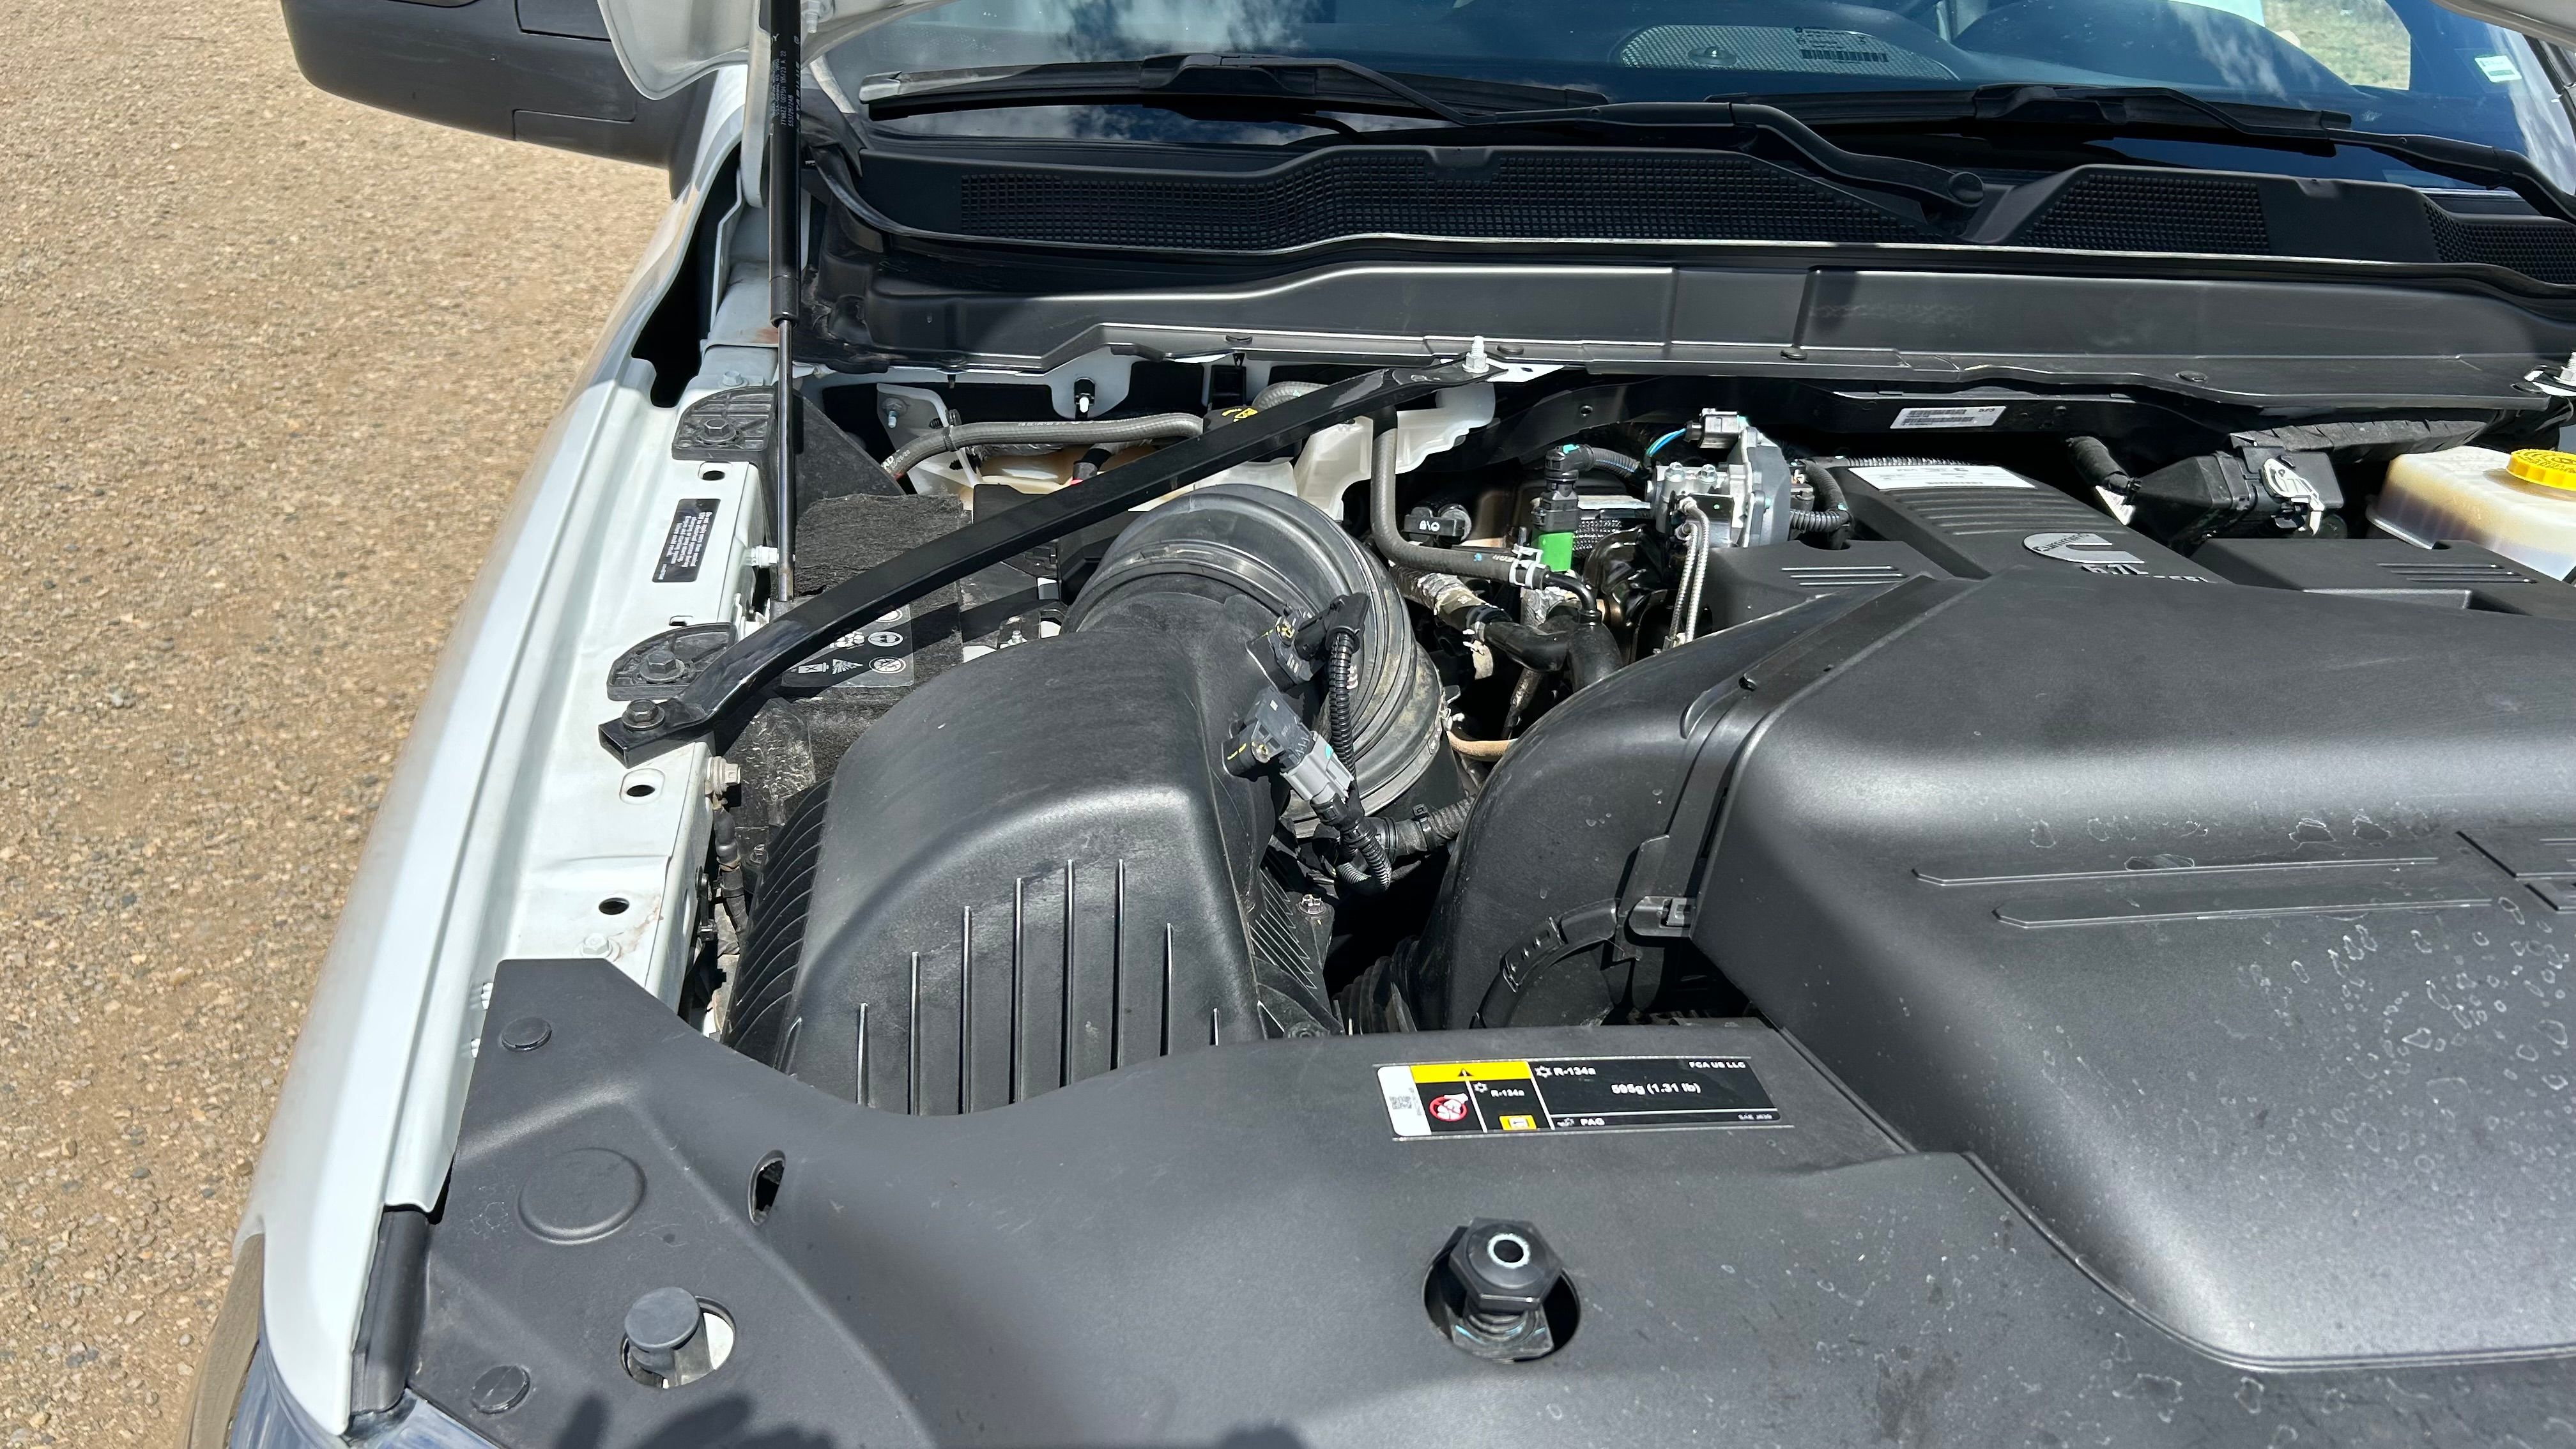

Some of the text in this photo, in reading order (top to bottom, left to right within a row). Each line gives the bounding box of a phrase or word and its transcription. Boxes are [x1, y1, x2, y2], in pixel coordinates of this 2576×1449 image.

[2032, 532, 2090, 551] Cummins
[1553, 1066, 1597, 1077] R-134a
[1491, 1089, 1526, 1098] R-134a
[1646, 1082, 1680, 1094] (1.31
[1682, 1082, 1701, 1094] lb)
[1580, 1117, 1606, 1126] PAG
